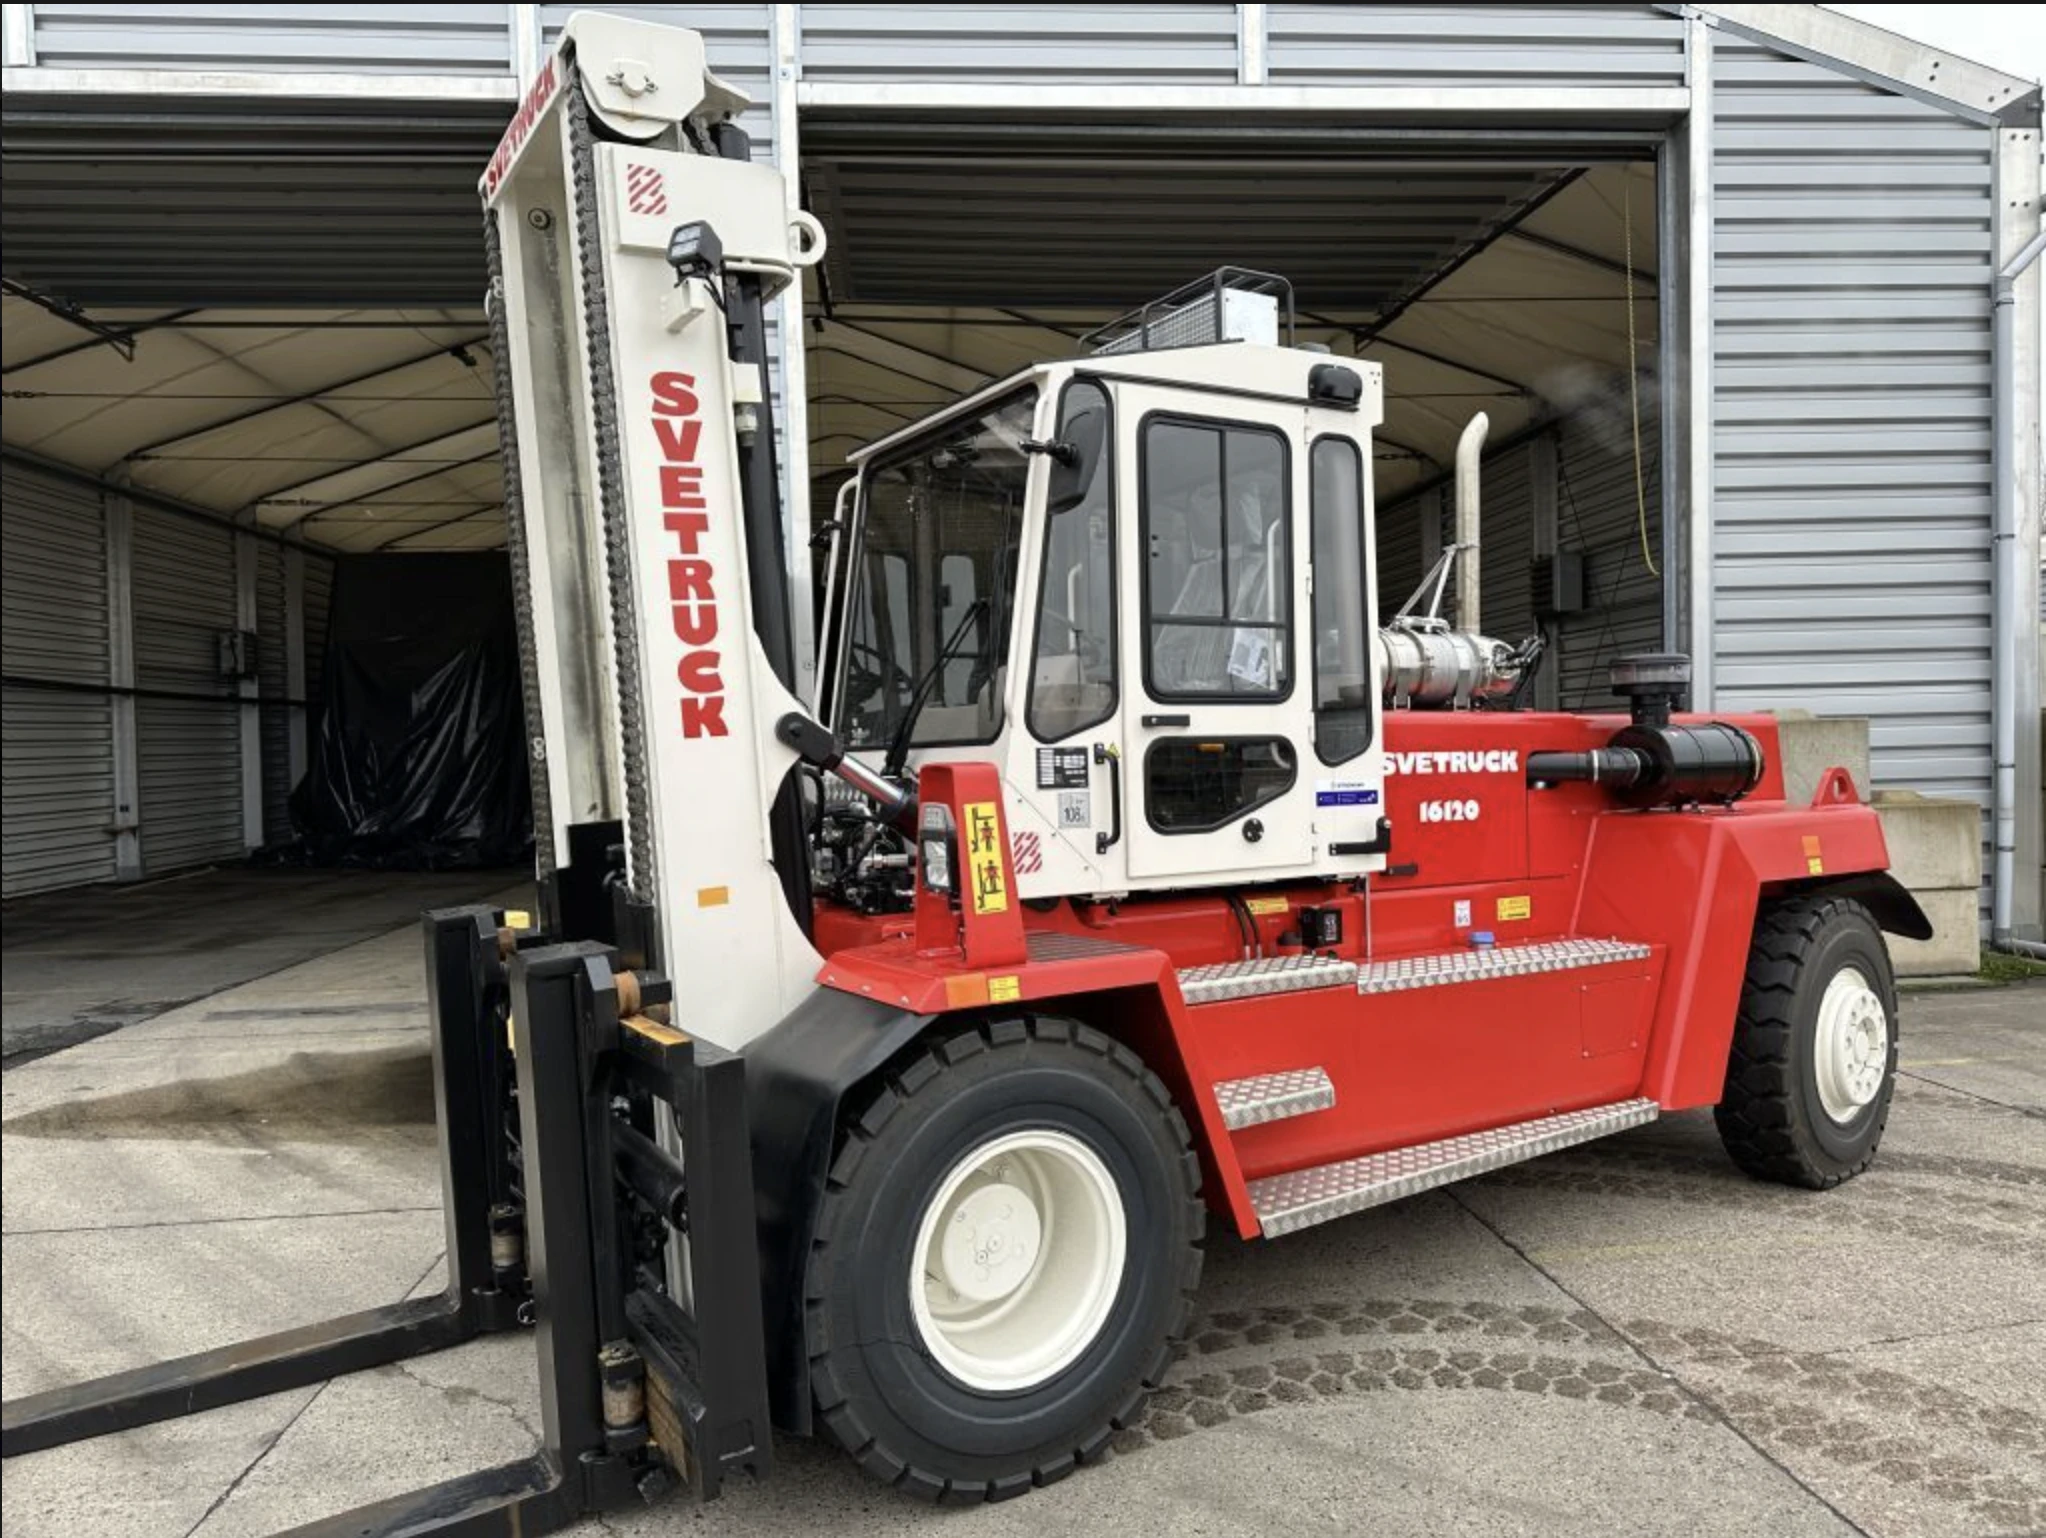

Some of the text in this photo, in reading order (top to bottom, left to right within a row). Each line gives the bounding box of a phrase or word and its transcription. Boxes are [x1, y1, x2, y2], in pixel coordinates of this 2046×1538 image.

[487, 55, 556, 196] SVETRUCK
[650, 371, 729, 739] SVETRUCK
[1382, 750, 1518, 776] SVETRUCK
[1419, 799, 1480, 823] 16120
